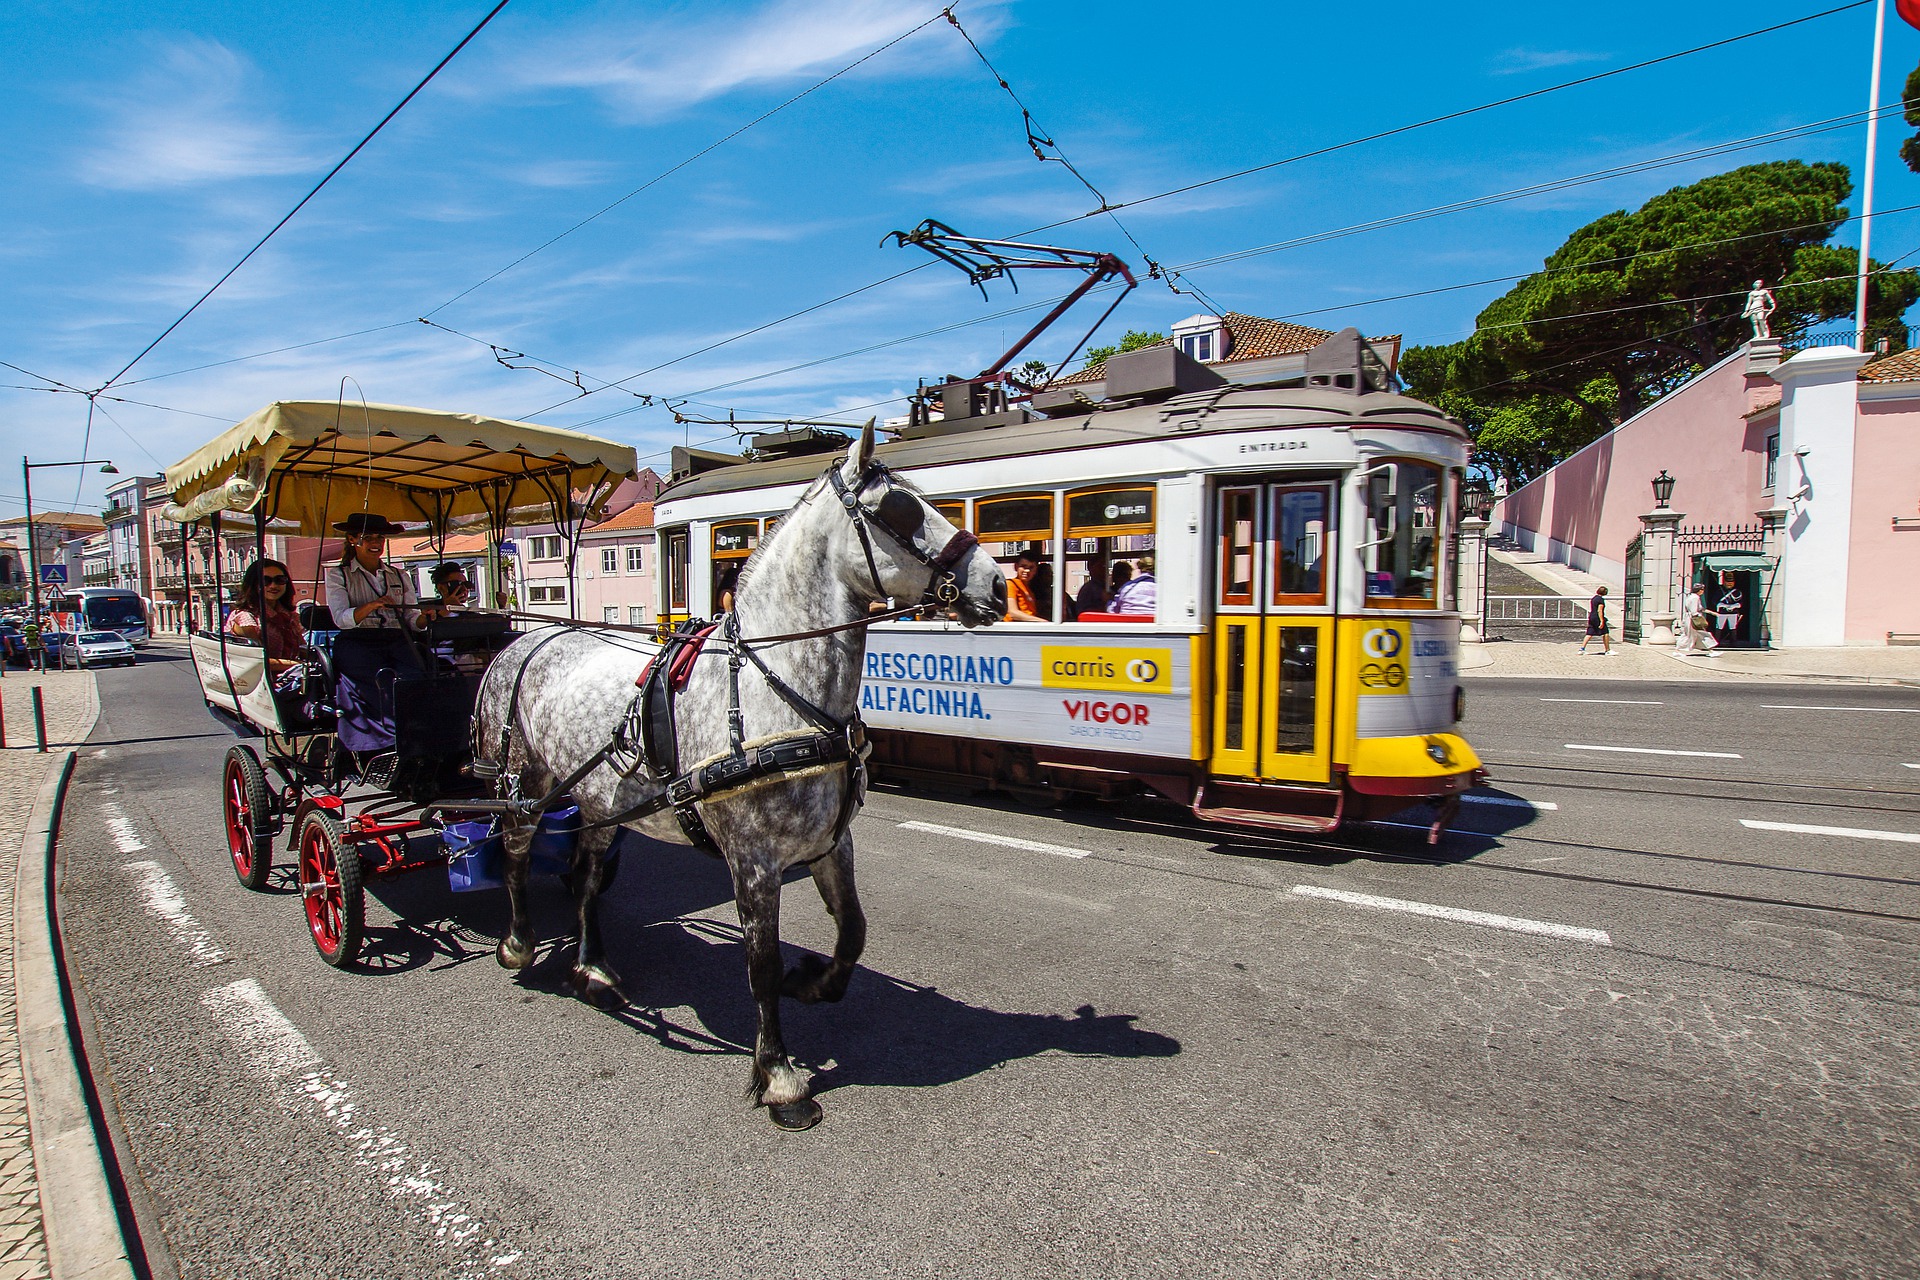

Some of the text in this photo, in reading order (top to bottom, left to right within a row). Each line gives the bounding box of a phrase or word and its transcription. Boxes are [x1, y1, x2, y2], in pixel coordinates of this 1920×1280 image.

[1239, 440, 1309, 454] ENTRADA
[866, 652, 1014, 686] RESCORIANO
[1052, 656, 1116, 678] carris
[862, 685, 992, 720] ALFACINHA.
[1062, 699, 1150, 726] VIGOR
[1069, 725, 1143, 741] SABOR FRESCO
